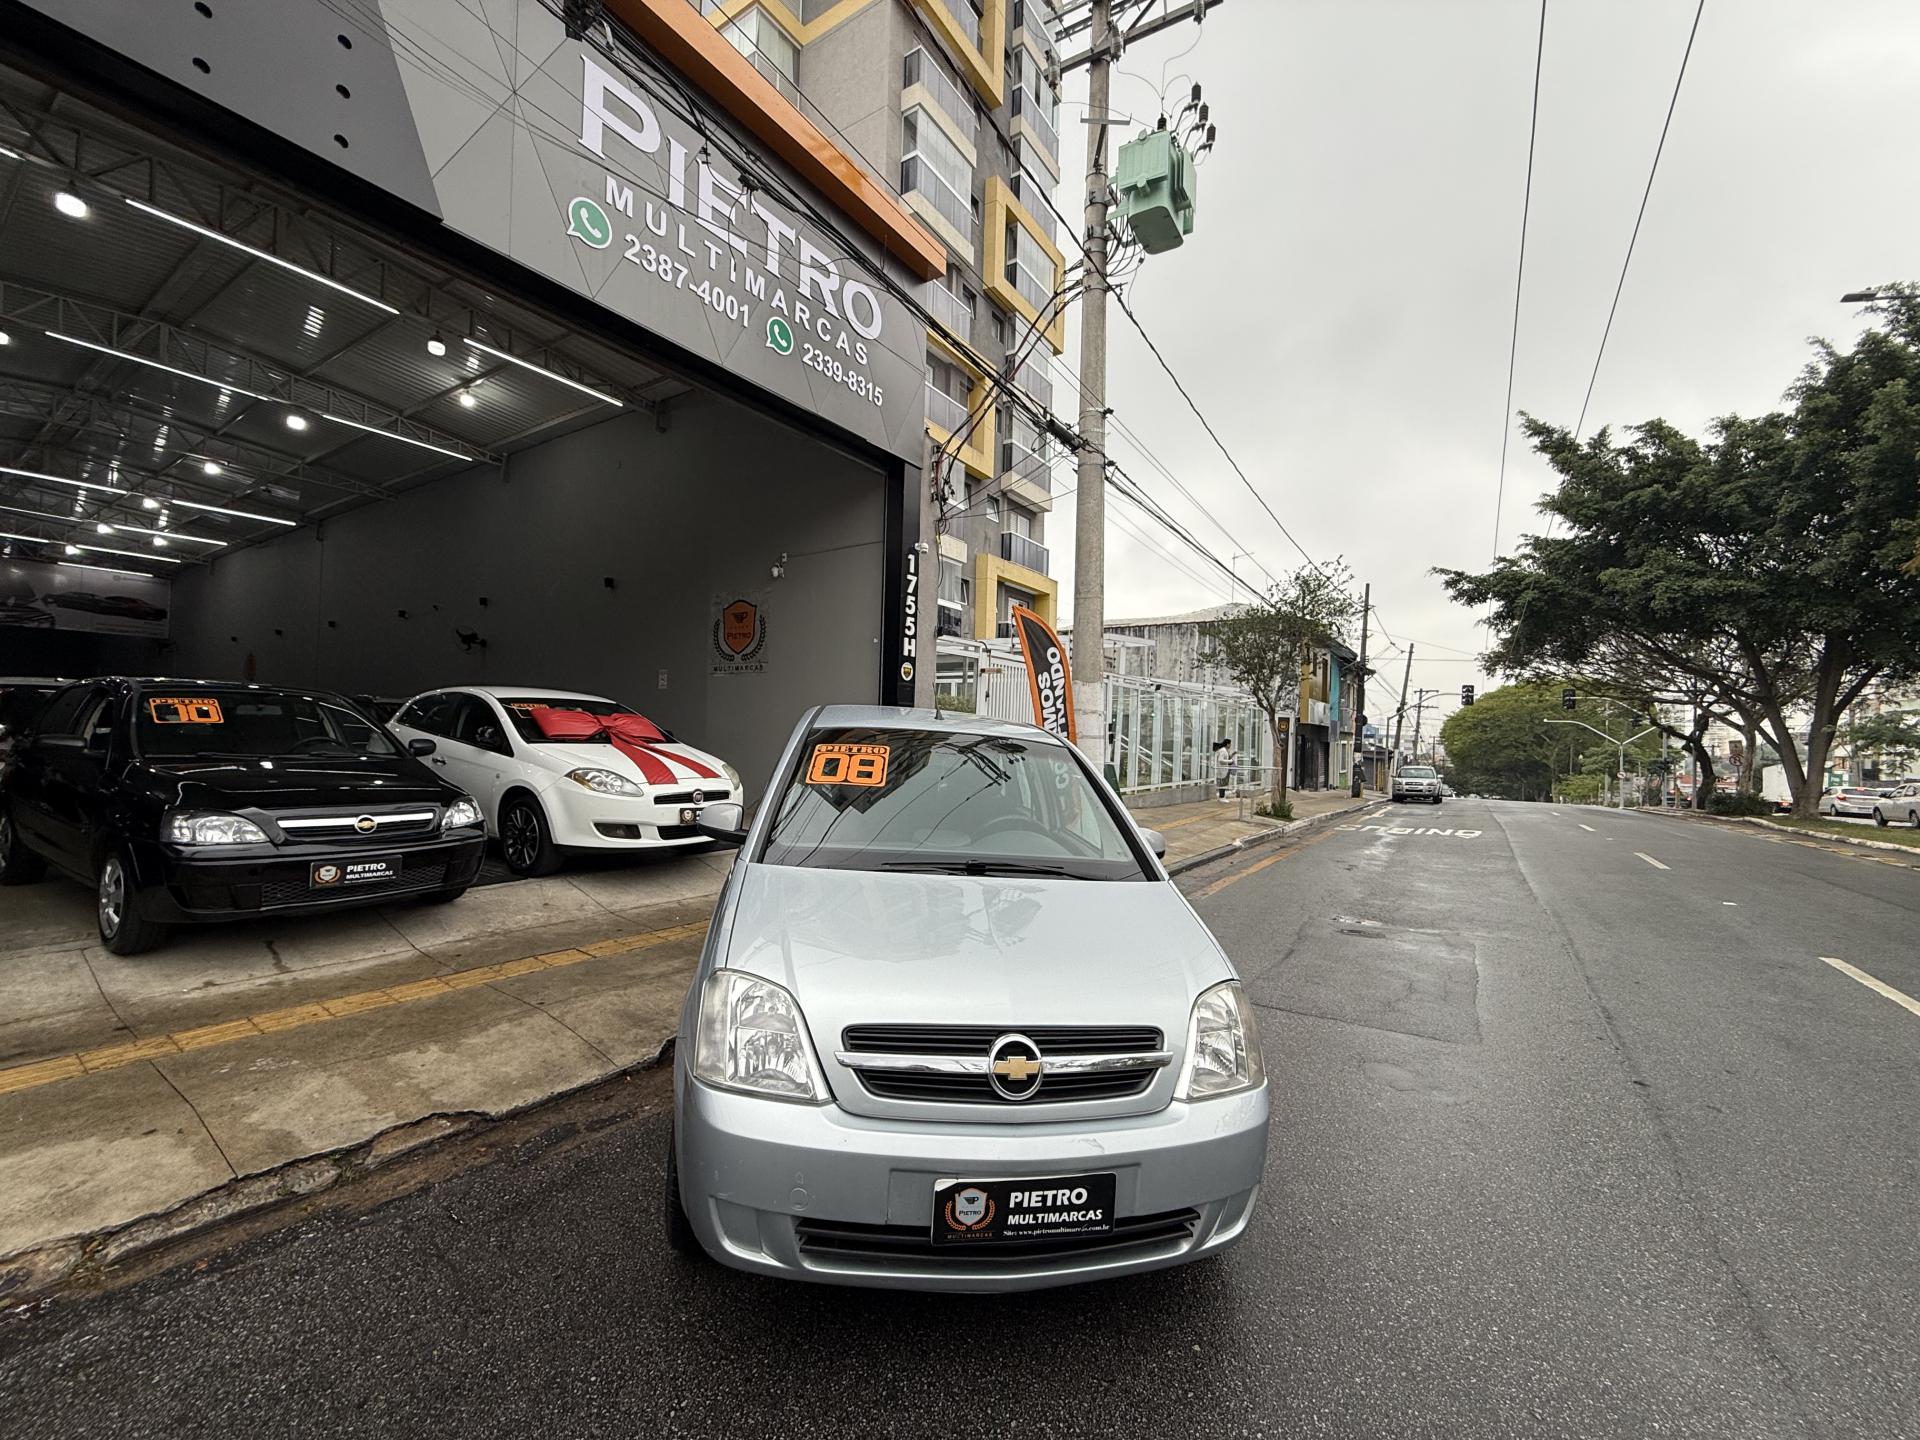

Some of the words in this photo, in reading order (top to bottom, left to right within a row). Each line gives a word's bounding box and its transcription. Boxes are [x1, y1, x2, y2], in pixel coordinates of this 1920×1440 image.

[577, 54, 882, 341] PIETRO
[605, 175, 868, 365] MULTIMARCAS
[624, 233, 750, 328] 2387-4001
[802, 343, 883, 407] 2339-8315
[903, 554, 918, 657] 1755H
[713, 664, 763, 672] MULTIMARCAS
[818, 745, 887, 753] PIETRO
[811, 754, 885, 784] 08
[346, 870, 393, 880] MULTIMARCAS
[347, 862, 387, 872] PIETRO
[1009, 1188, 1088, 1208] PIETRO
[1007, 1209, 1103, 1225] MULTIMARCAS
